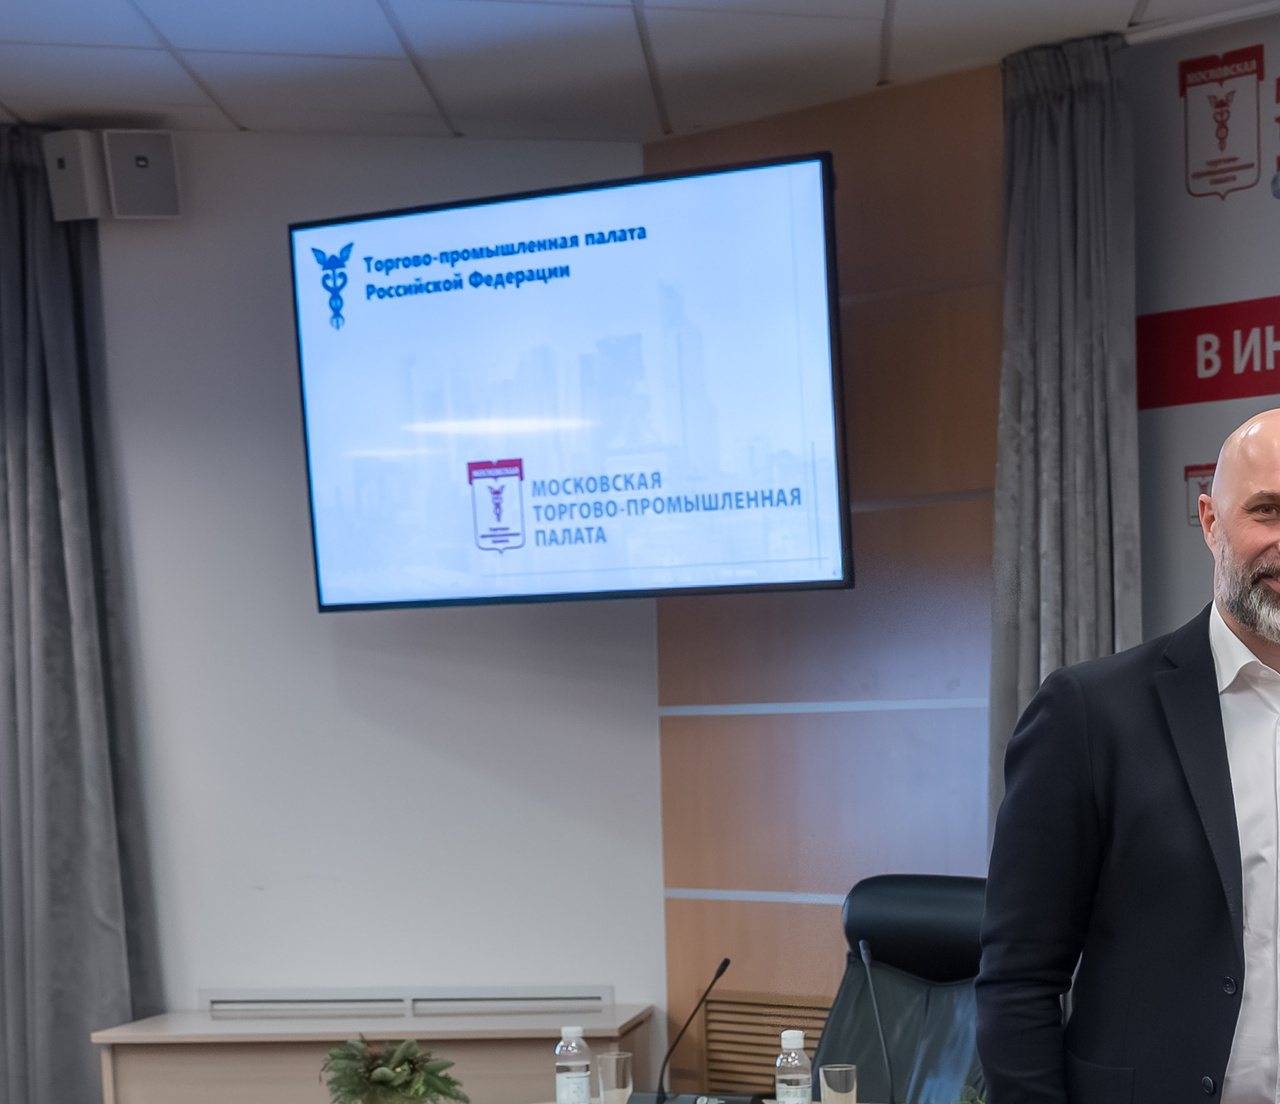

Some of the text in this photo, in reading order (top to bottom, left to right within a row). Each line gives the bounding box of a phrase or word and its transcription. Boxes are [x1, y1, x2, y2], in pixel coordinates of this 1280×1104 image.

[363, 226, 647, 276] Торгово-промышленная палата
[366, 265, 570, 300] Российской Федерации
[1196, 333, 1222, 379] В
[531, 471, 662, 497] МОСКОВСКАЯ
[533, 487, 802, 522] ТОРГОВО-ПРОМЫШЛЕННАЯ
[535, 526, 607, 547] ПАЛАТА
